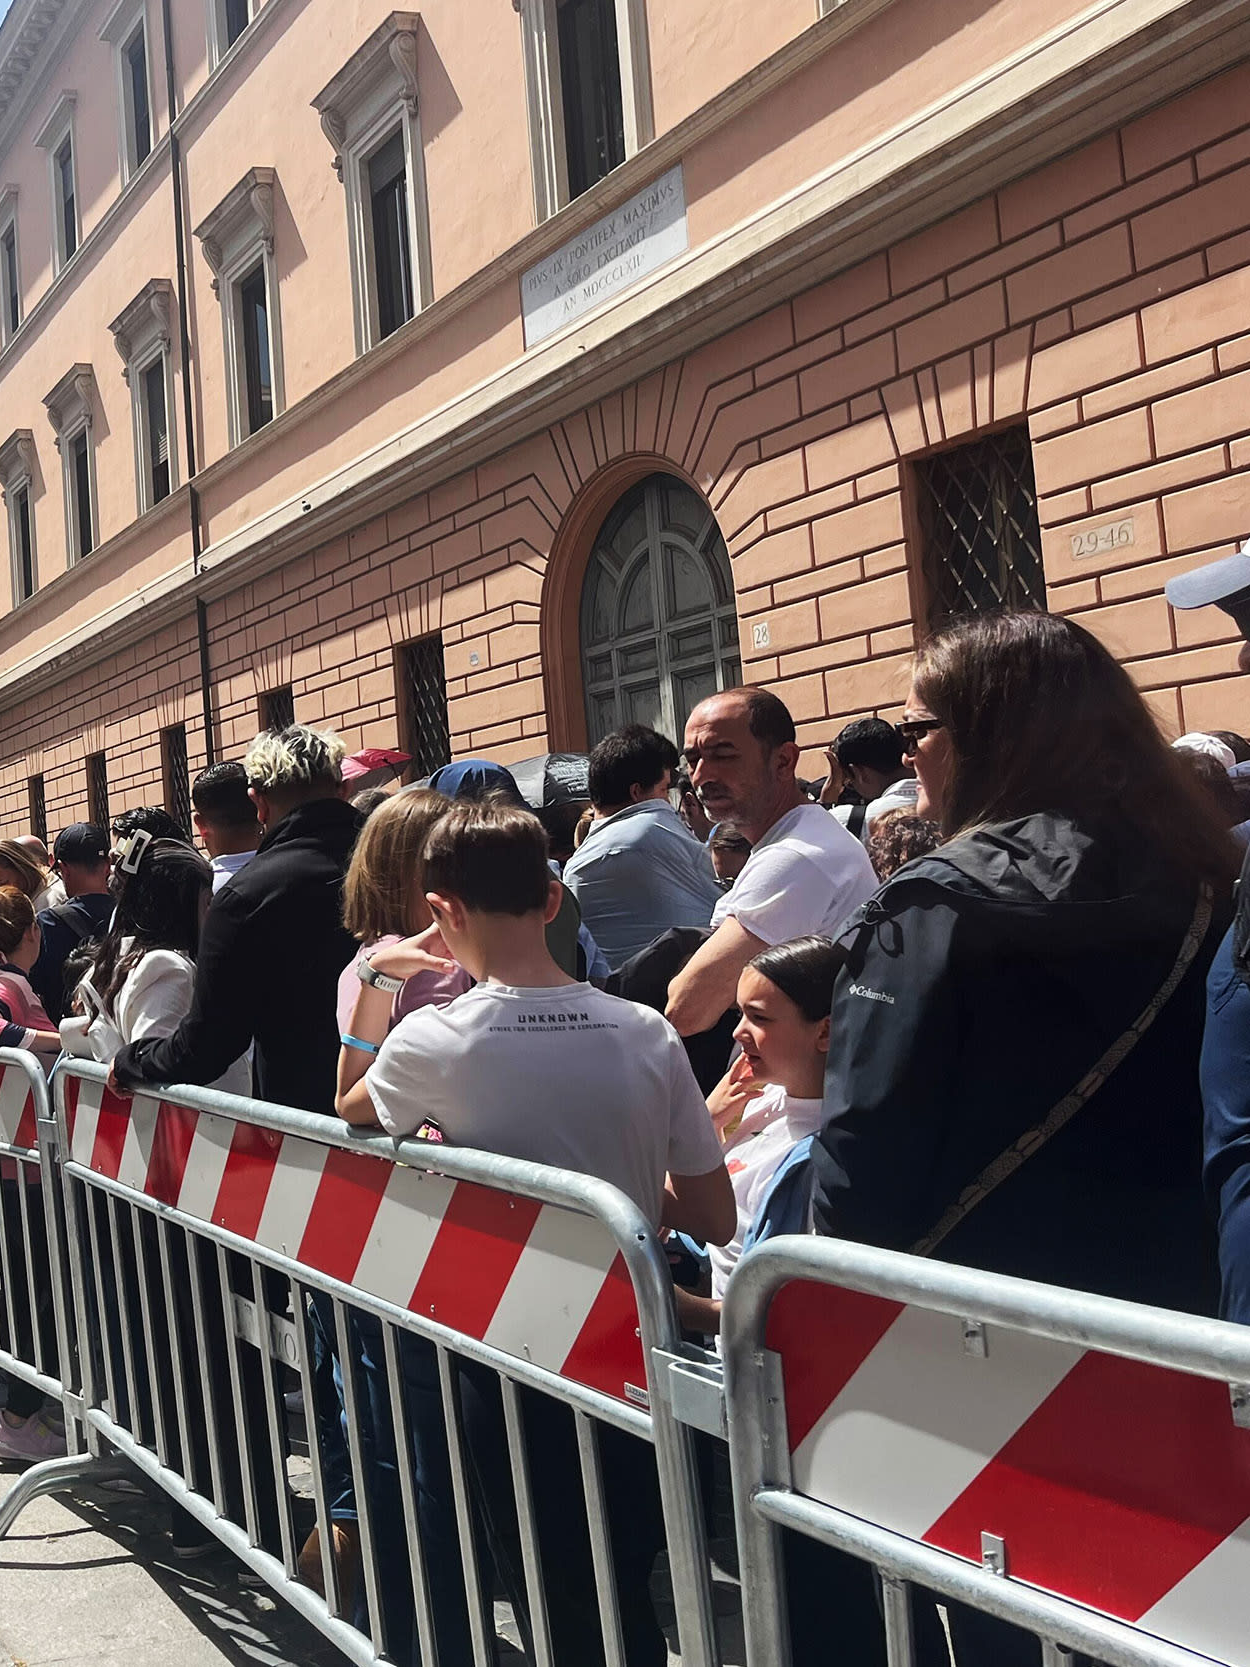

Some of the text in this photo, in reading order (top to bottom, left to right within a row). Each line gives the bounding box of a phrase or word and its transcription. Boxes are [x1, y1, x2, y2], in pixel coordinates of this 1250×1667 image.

[569, 220, 616, 265] PONTIFEX
[623, 183, 674, 225] MAXIMVS
[567, 264, 591, 289] SOLO
[597, 226, 647, 268] EXCITAVIT
[1073, 522, 1132, 556] 29-46
[754, 625, 768, 644] 28
[856, 985, 895, 1005] Columbia
[518, 1013, 589, 1023] UNKNOWN
